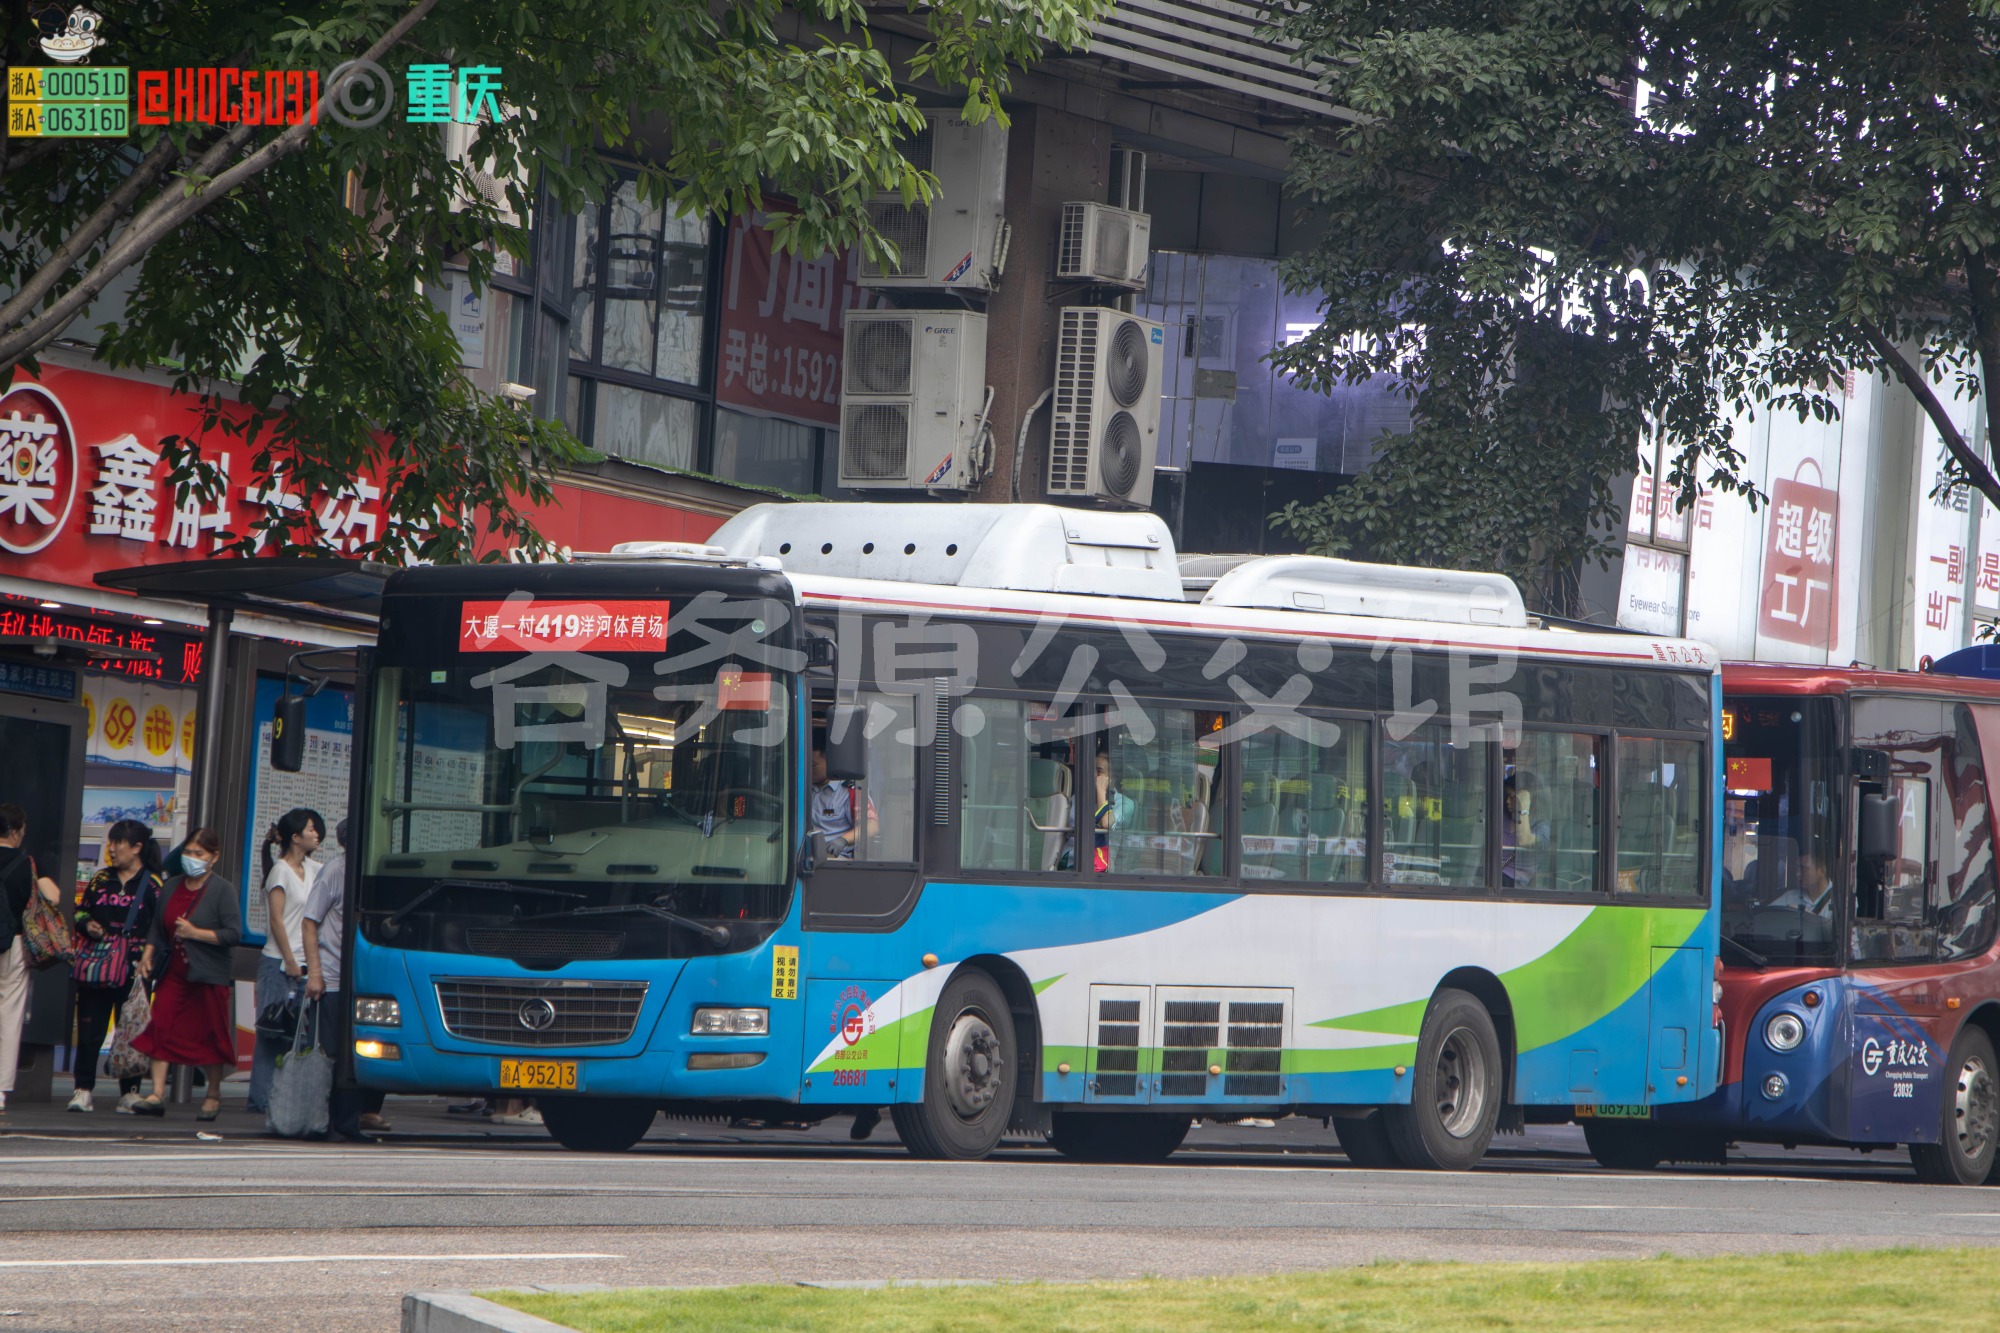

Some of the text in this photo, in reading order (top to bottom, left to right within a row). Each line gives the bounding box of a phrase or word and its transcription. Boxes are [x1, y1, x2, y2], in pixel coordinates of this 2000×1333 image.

[724, 328, 844, 406] 尹总:1592
[1635, 475, 1714, 530] 品质后
[1774, 500, 1833, 566] 超级
[1629, 594, 1661, 613] Eyewear
[1771, 574, 1828, 628] 工厂
[463, 613, 664, 640] 大堰一村419洋河体育场
[1651, 643, 1708, 665] 重庆公交
[775, 956, 786, 998] 视线盲区
[786, 957, 797, 999] 请勿靠近
[1886, 1039, 1929, 1067] 重庆公交
[832, 1068, 867, 1087] 26681
[1893, 1082, 1914, 1098] 23032
